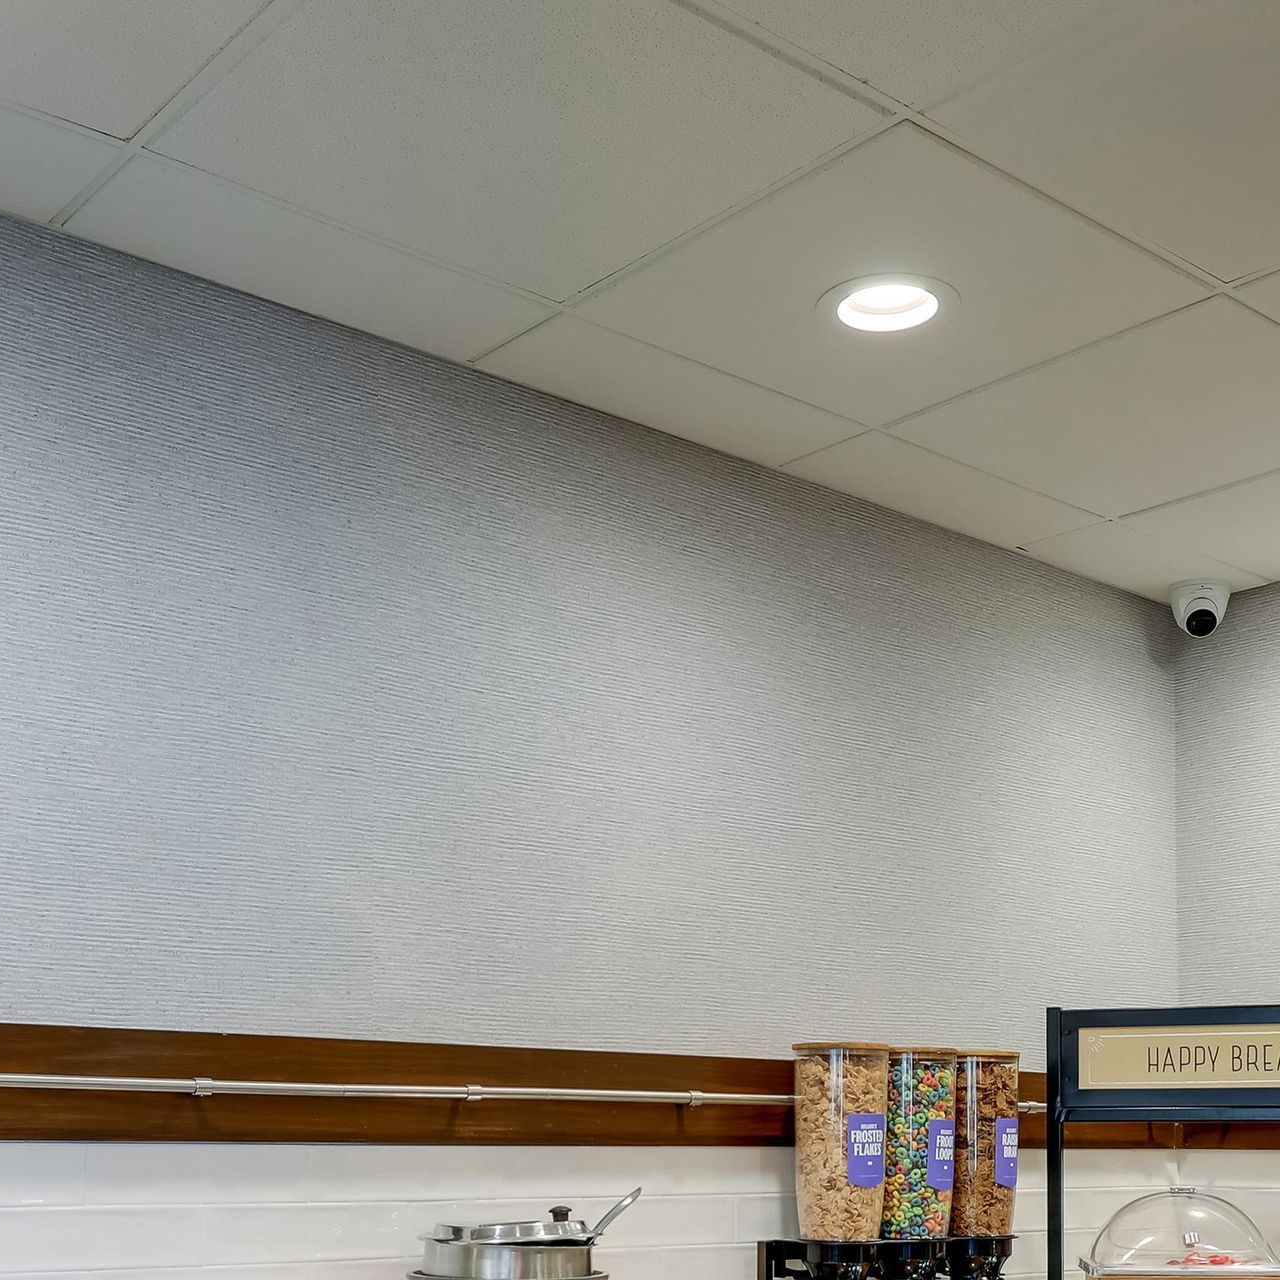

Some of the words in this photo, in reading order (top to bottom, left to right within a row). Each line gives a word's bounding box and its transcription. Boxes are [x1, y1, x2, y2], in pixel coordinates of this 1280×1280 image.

[1147, 1044, 1220, 1073] HAPPY
[851, 1130, 883, 1143] FROSTED
[1002, 1134, 1018, 1146] RAISI
[854, 1143, 882, 1156] FLAKES
